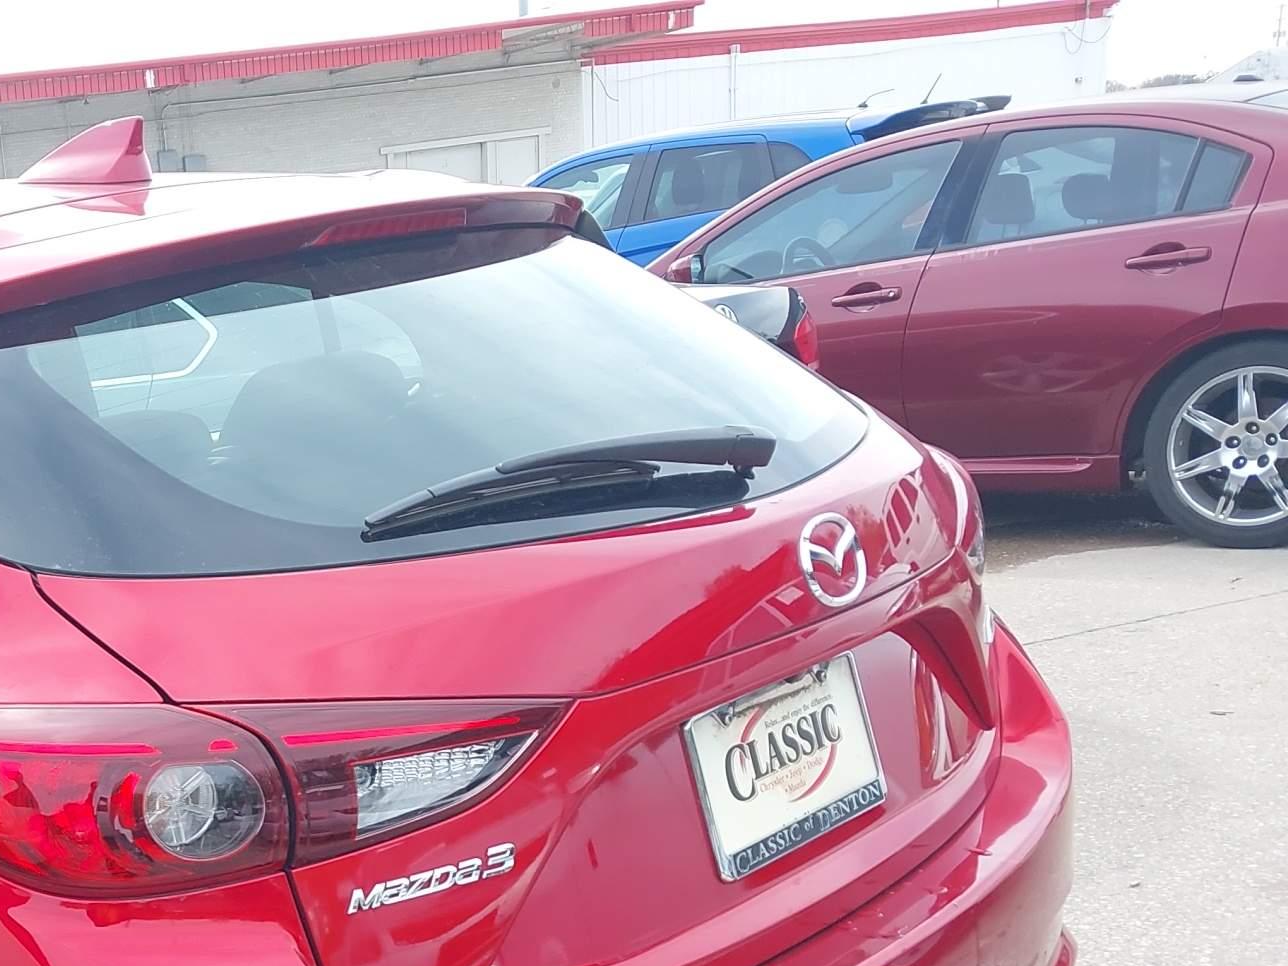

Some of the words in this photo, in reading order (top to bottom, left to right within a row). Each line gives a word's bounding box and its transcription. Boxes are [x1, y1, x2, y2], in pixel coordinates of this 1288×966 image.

[725, 703, 841, 801] CLASSIC
[736, 823, 803, 873] CLASSIC
[804, 815, 815, 832] of
[817, 782, 881, 832] DENTON
